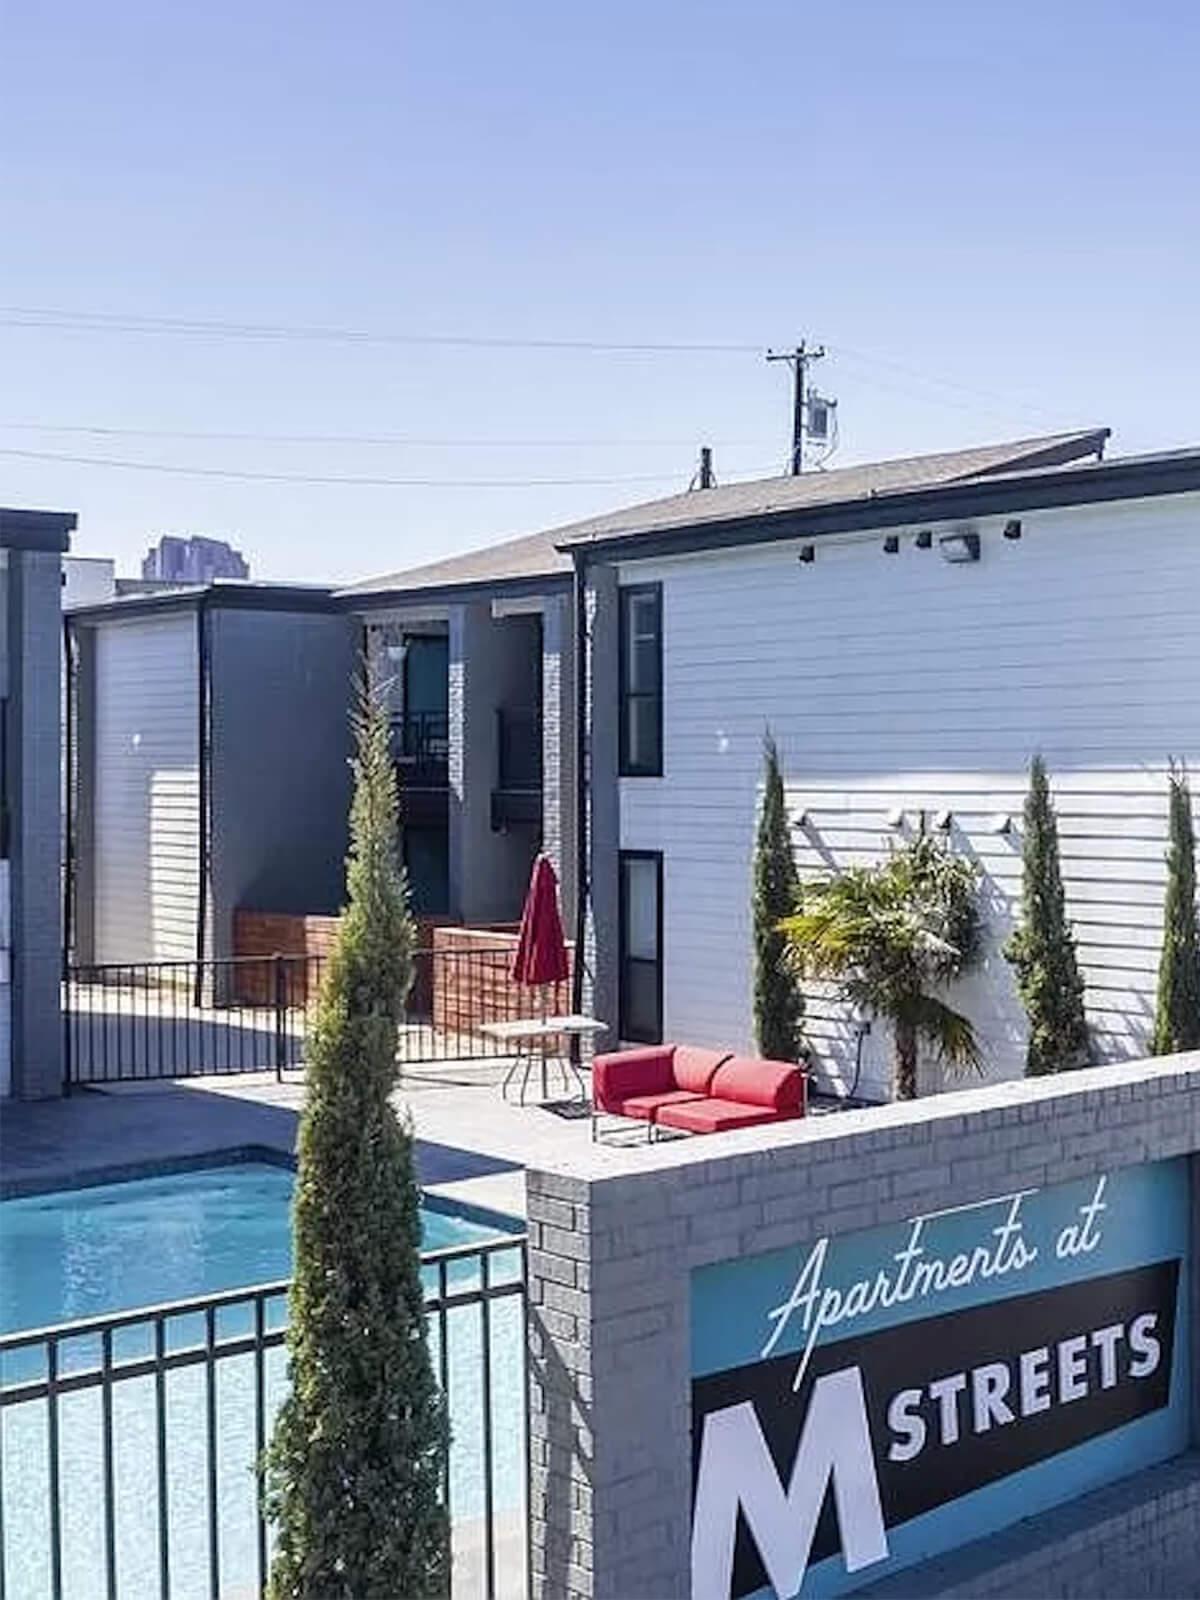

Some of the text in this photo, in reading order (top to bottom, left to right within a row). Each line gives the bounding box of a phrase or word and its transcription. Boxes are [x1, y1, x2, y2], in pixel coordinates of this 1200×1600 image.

[760, 1175, 1107, 1392] Apartments at
[691, 1313, 1161, 1600] M STREETS
